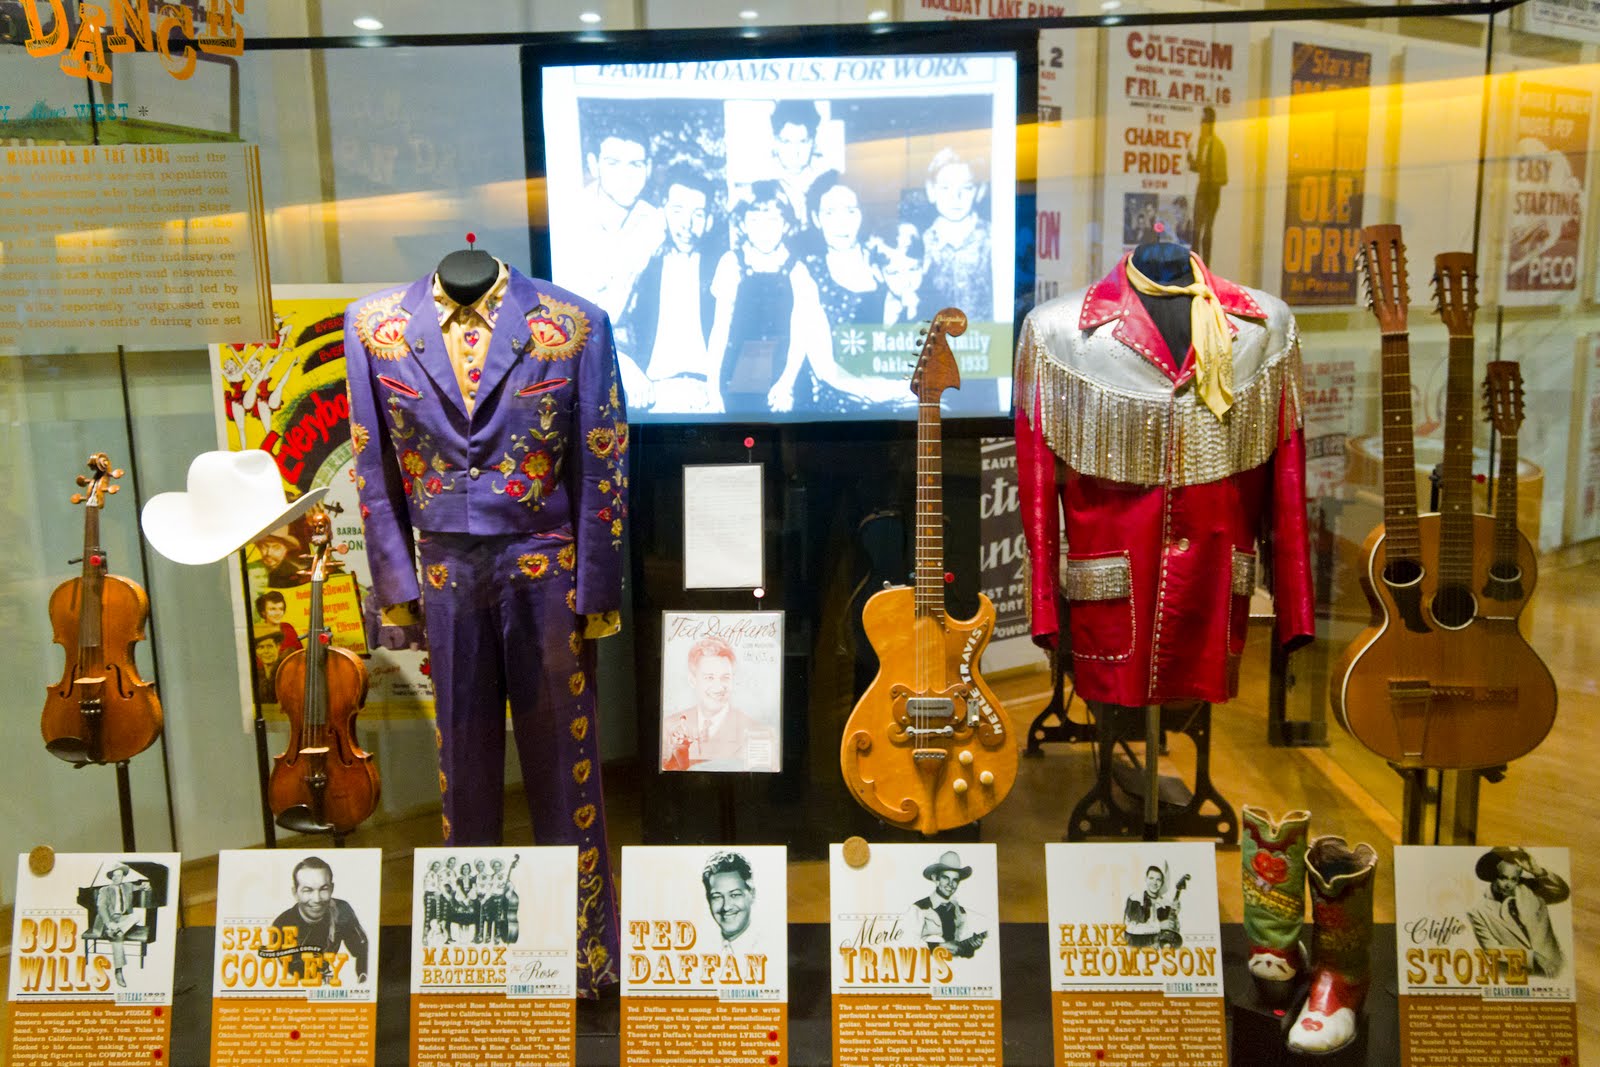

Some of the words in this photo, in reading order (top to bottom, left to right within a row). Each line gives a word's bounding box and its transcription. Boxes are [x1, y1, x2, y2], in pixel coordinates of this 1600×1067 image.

[988, 0, 1022, 18] LAKE
[1027, 2, 1065, 18] PARK
[24, 0, 245, 84] DANCE
[597, 62, 688, 80] FAMILY
[695, 61, 781, 81] ROAMS
[787, 61, 826, 81] U.S.
[834, 60, 886, 81] FOR
[894, 57, 969, 79] WORK
[73, 103, 129, 122] WEST
[1124, 128, 1192, 149] CHARLEY
[1123, 151, 1183, 175] PRIDE
[1513, 189, 1581, 216] STARTING
[1284, 226, 1361, 273] OPRY
[1527, 256, 1577, 286] PECO
[163, 283, 194, 295] band
[200, 283, 218, 294] led
[223, 283, 240, 296] by
[211, 301, 240, 310] even
[149, 316, 192, 328] during
[197, 317, 220, 326] one
[223, 315, 243, 326] set
[960, 355, 989, 372] 1933
[668, 616, 704, 642] Ted
[704, 616, 777, 646] Daffan's
[960, 628, 983, 685] TRAVIS
[969, 687, 1003, 735] MERLE
[20, 917, 79, 954] BOB
[222, 926, 299, 951] SPADE
[628, 919, 697, 951] TED
[840, 915, 905, 951] Merle
[1058, 923, 1129, 948] HANK
[1404, 915, 1467, 946] Cliffie
[422, 946, 508, 966] MADDOX
[839, 946, 954, 984] TRAVIS
[1059, 946, 1218, 978] THOMPSON
[1405, 948, 1530, 986] STONE
[19, 955, 112, 992] WILLS
[221, 953, 349, 989] COOLEY
[422, 968, 508, 985] BROTHERS
[518, 960, 560, 983] Rose
[627, 953, 769, 985] DAFFAN
[124, 992, 143, 1002] TEXAS
[317, 989, 349, 999] OKLAHOMA
[510, 984, 535, 995] FORMED
[726, 988, 760, 999] LOUISIANA
[940, 986, 972, 997] KENTUCKY
[1492, 987, 1531, 998] CALIFORNIA
